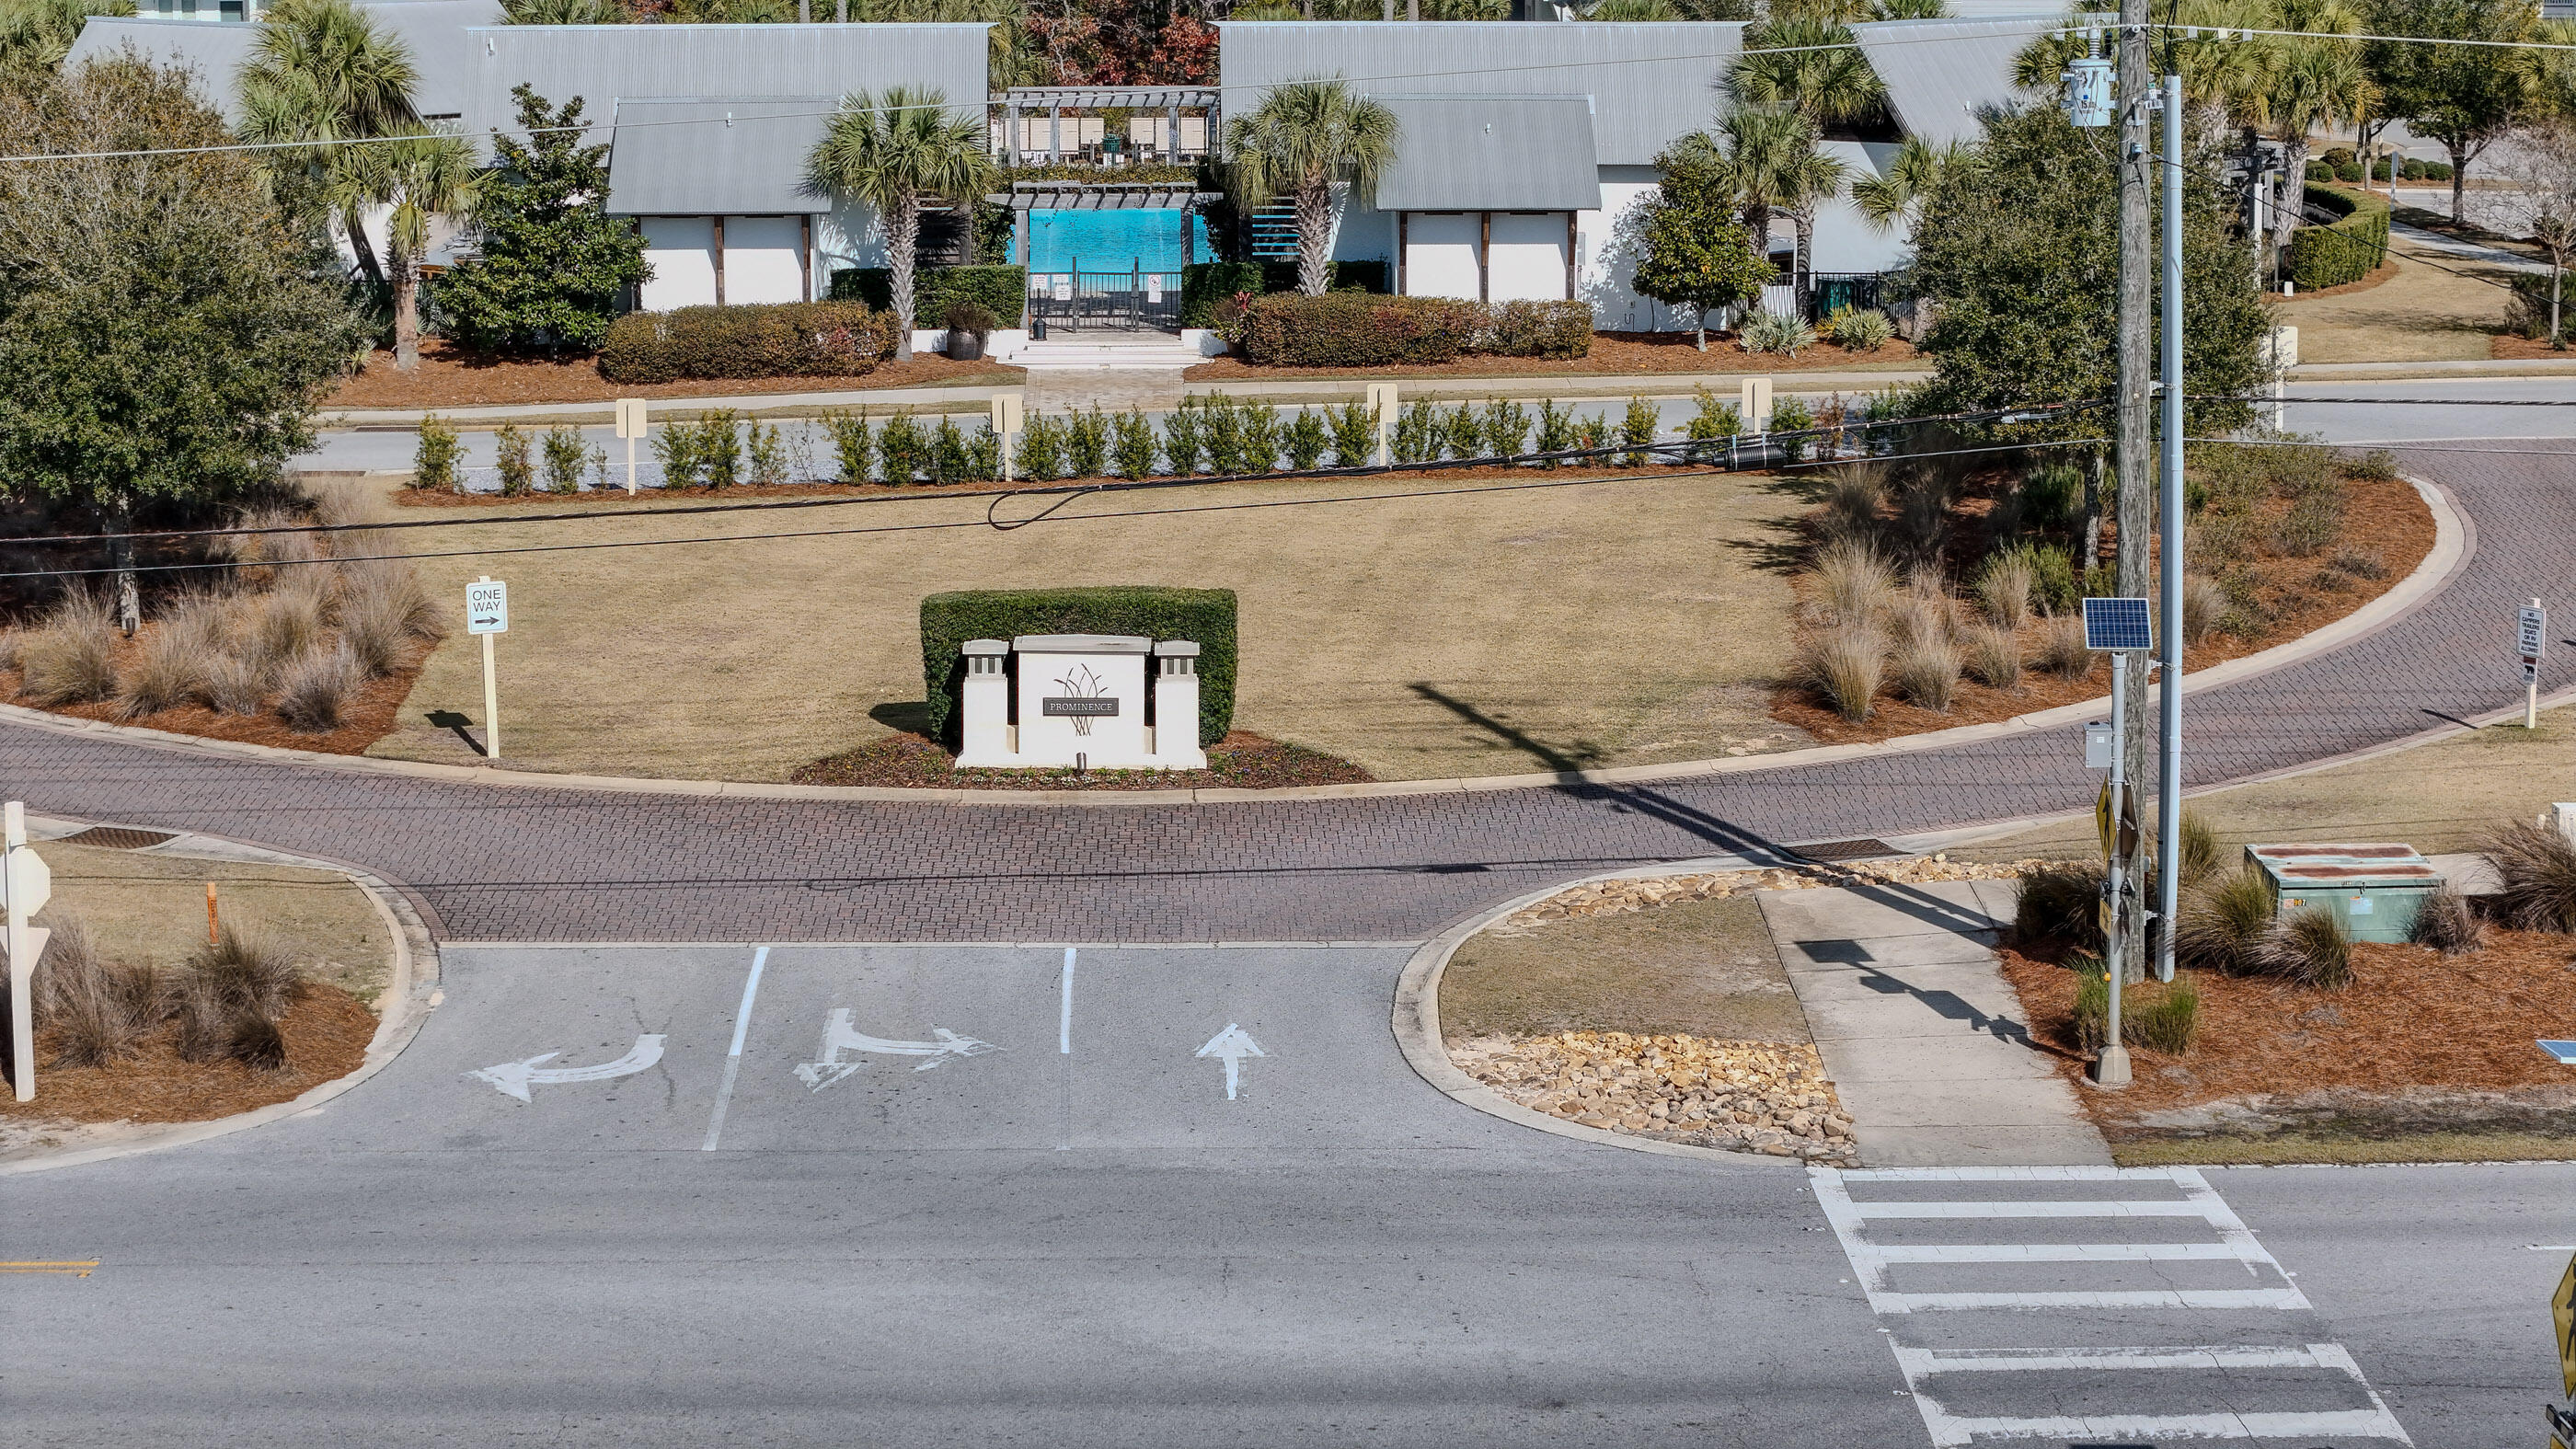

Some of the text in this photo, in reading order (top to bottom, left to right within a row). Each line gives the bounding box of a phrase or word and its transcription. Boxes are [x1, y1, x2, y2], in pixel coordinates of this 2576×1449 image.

[472, 589, 501, 601] ONE
[473, 601, 500, 612] WAY
[2522, 616, 2540, 625] CAMPERS
[2522, 622, 2540, 630] TRAILERS
[2522, 639, 2538, 648] PARKING
[1050, 703, 1113, 711] PROMINENCE
